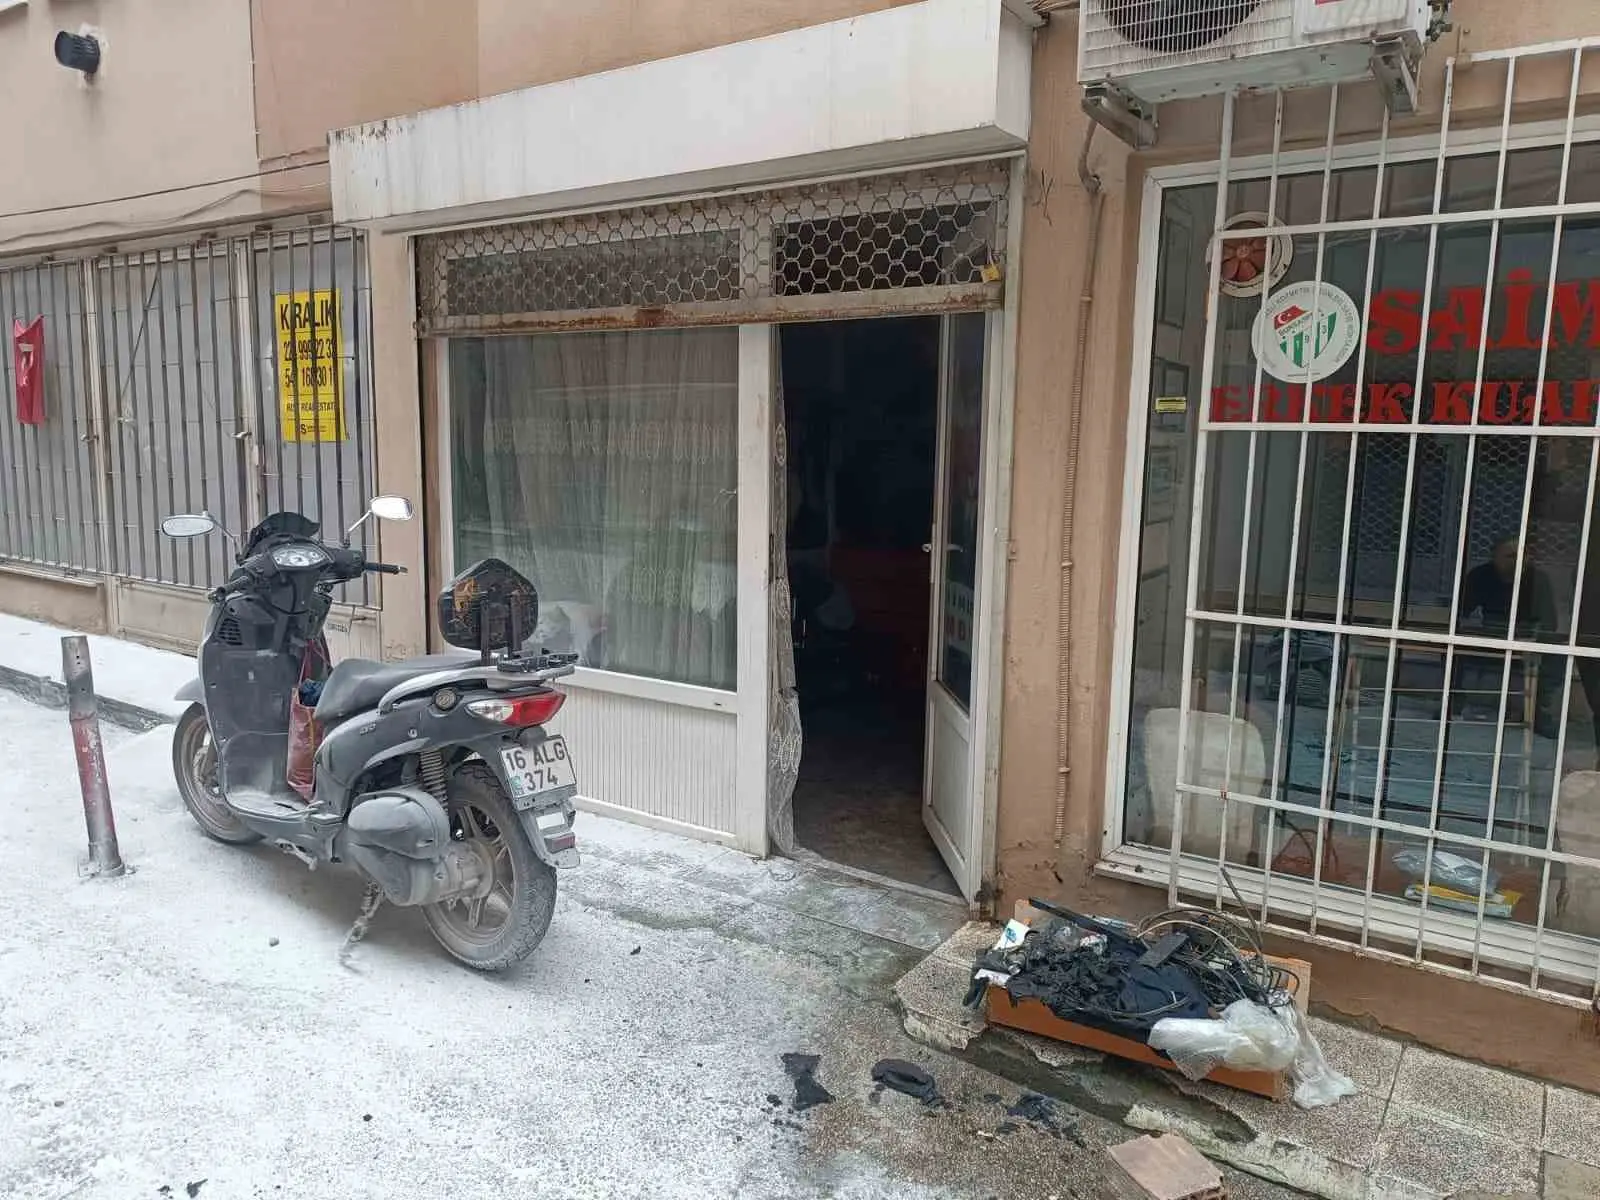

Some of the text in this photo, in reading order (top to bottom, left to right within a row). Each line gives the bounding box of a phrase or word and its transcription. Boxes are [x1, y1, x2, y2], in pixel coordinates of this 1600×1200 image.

[280, 299, 336, 330] KRALIK
[506, 742, 565, 770] 16 ALG
[524, 767, 558, 791] 374
